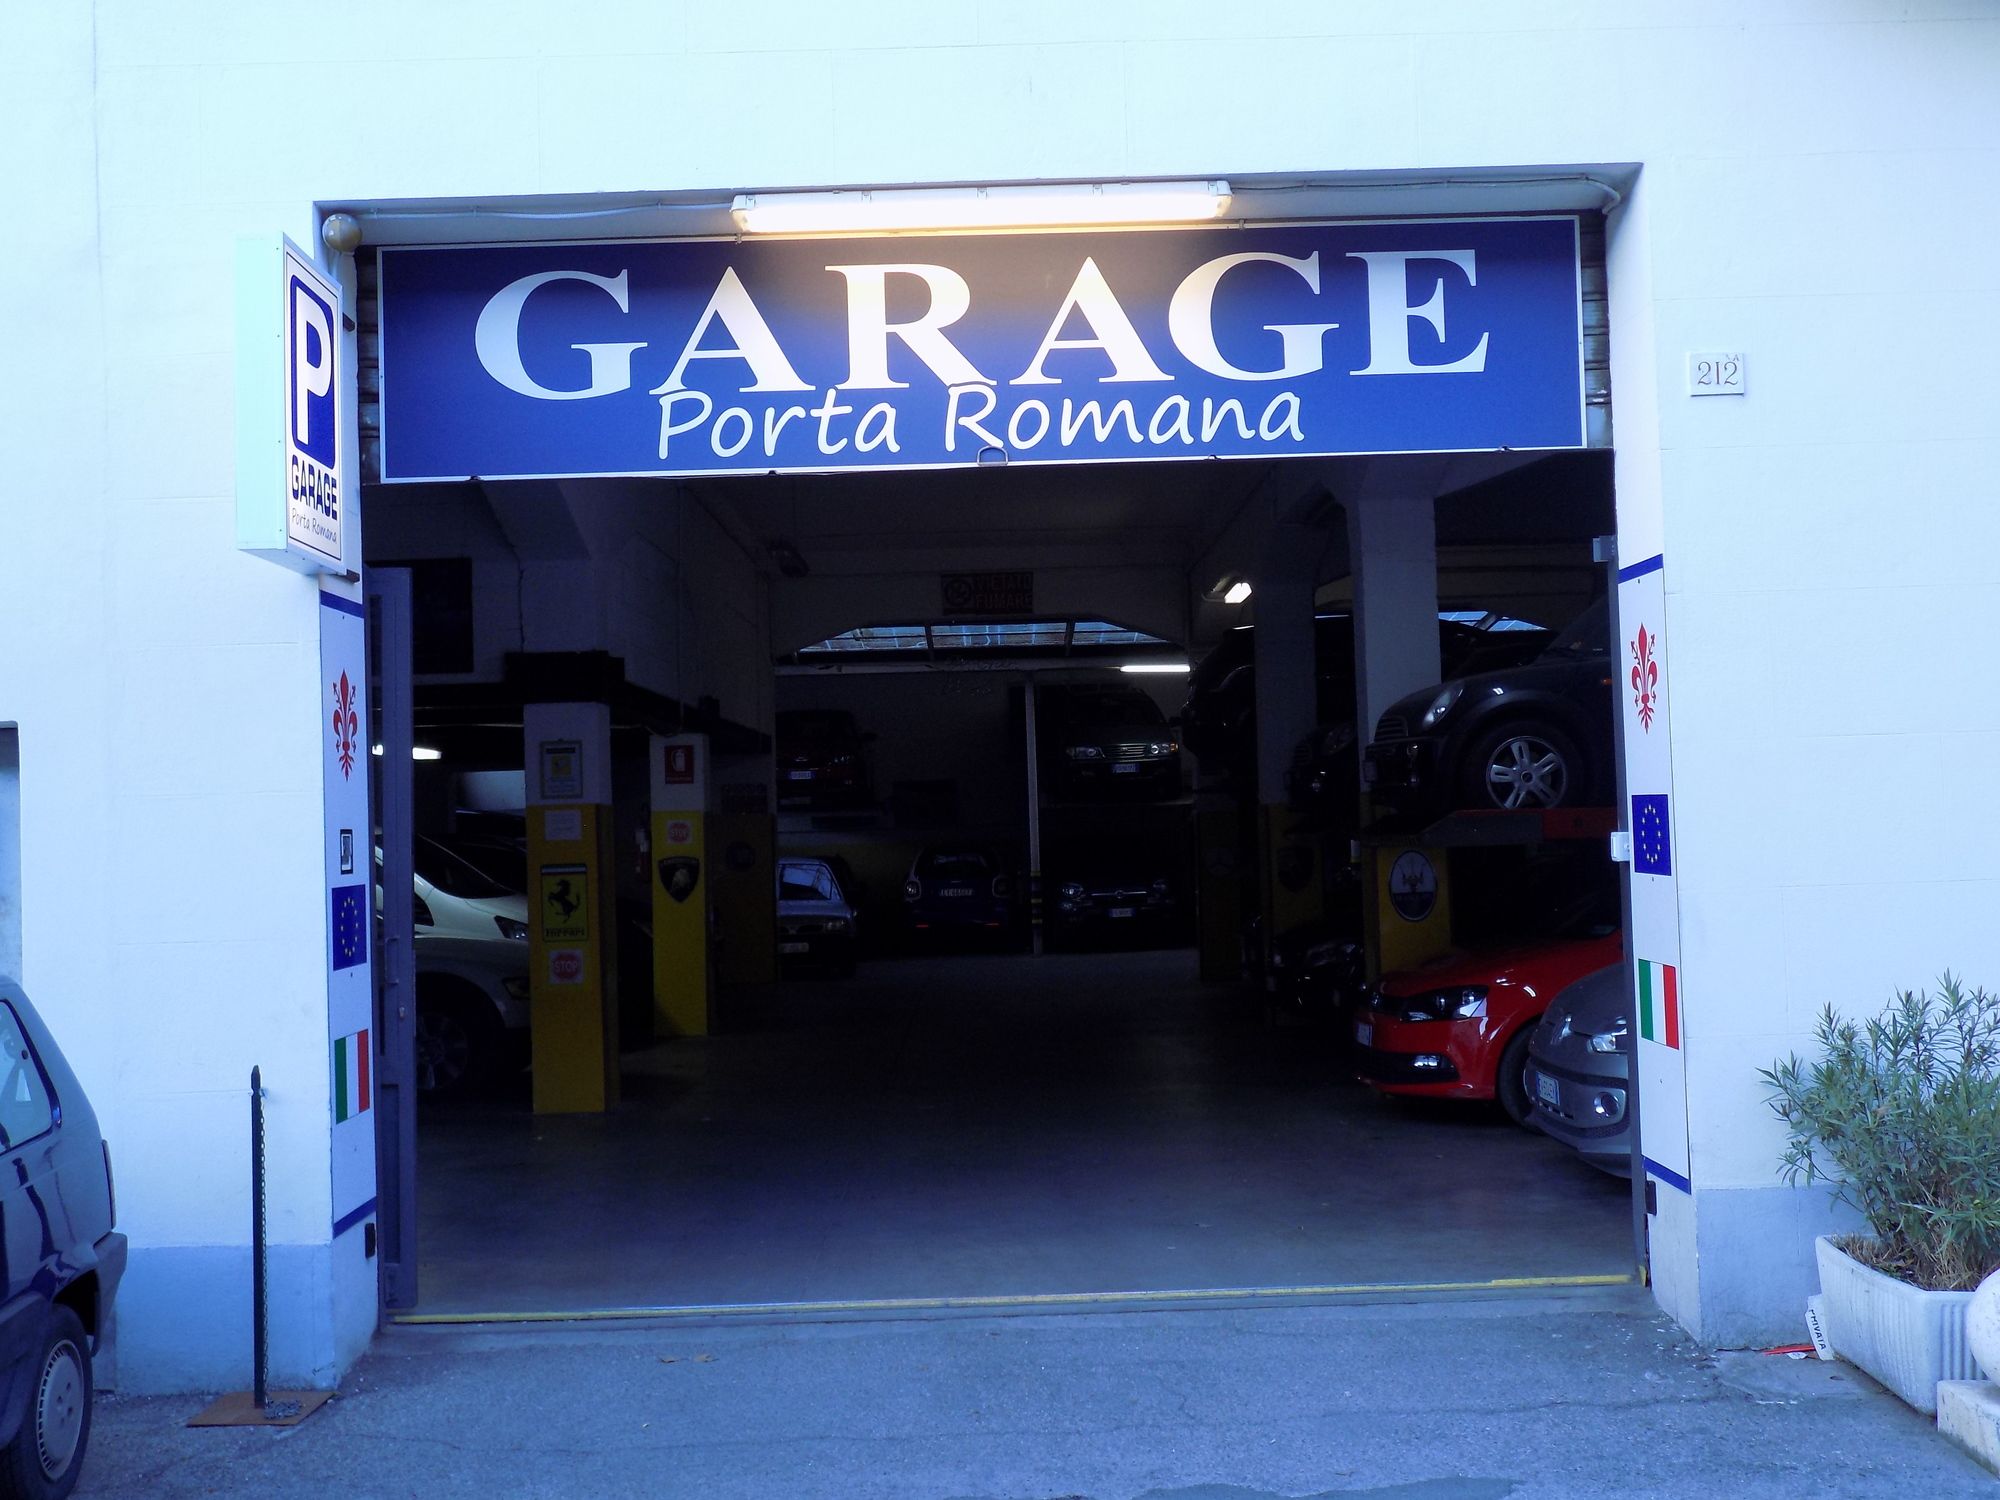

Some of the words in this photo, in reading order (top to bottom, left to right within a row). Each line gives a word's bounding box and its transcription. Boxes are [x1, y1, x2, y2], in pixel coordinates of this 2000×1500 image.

[475, 249, 1489, 400] GARAGE
[296, 286, 331, 446] P
[1698, 361, 1738, 385] 212
[658, 388, 900, 460] Porta
[944, 382, 1304, 452] Romana
[291, 454, 338, 521] GARAGE
[291, 507, 310, 532] Porta
[312, 517, 338, 545] Romana
[554, 959, 578, 973] STOP
